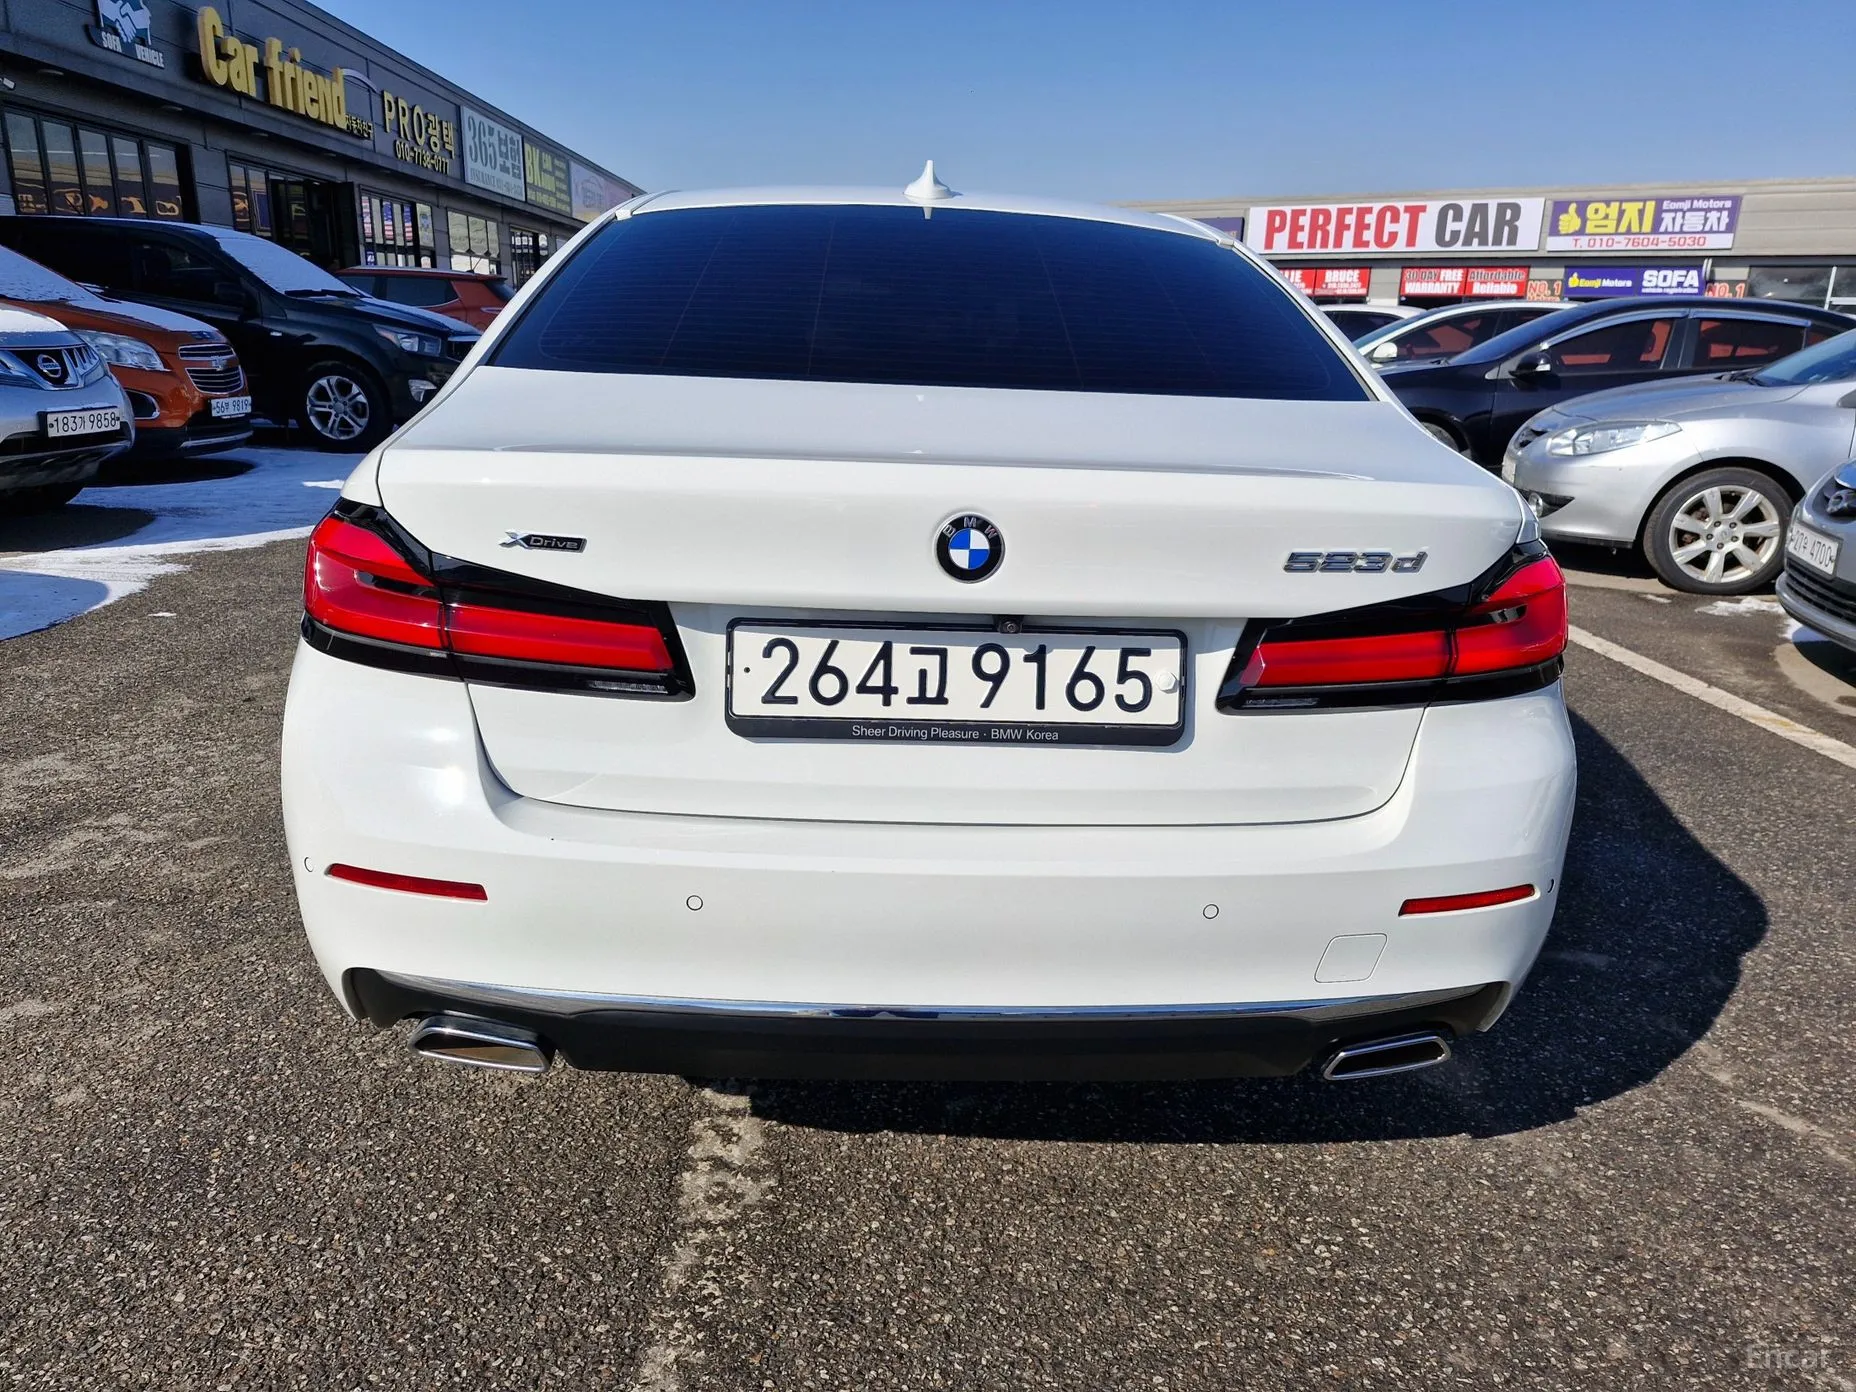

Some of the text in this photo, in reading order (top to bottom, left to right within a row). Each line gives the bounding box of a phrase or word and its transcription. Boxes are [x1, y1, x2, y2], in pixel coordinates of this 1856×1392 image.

[101, 31, 165, 68] SOFA VEHICLE
[197, 6, 347, 129] Car friend
[1662, 198, 1732, 211] Eomji Motors
[1585, 200, 1656, 234] 엄지
[1659, 210, 1729, 233] 자동차
[1264, 202, 1522, 250] PERFECT CAR
[1573, 236, 1706, 248] T. 010-7604-5030
[1325, 269, 1360, 283] BRUCE
[1406, 268, 1463, 281] 30 DAY FREE
[1469, 269, 1525, 281] Affordable
[1642, 269, 1699, 287] SOFA
[1405, 281, 1460, 294] WARRANTY
[1472, 282, 1518, 294] Reliable
[1527, 280, 1562, 295] NO. 1
[1602, 278, 1632, 288] Motors
[1735, 282, 1745, 298] 1
[232, 399, 249, 412] 9819
[88, 411, 116, 430] 9858
[942, 516, 998, 539] BMW
[1810, 540, 1833, 568] 4700
[1283, 551, 1429, 574] 523d
[760, 637, 1154, 713] 264고 9165
[852, 725, 1059, 740] Sheer Driving Pleasure BMW Korea
